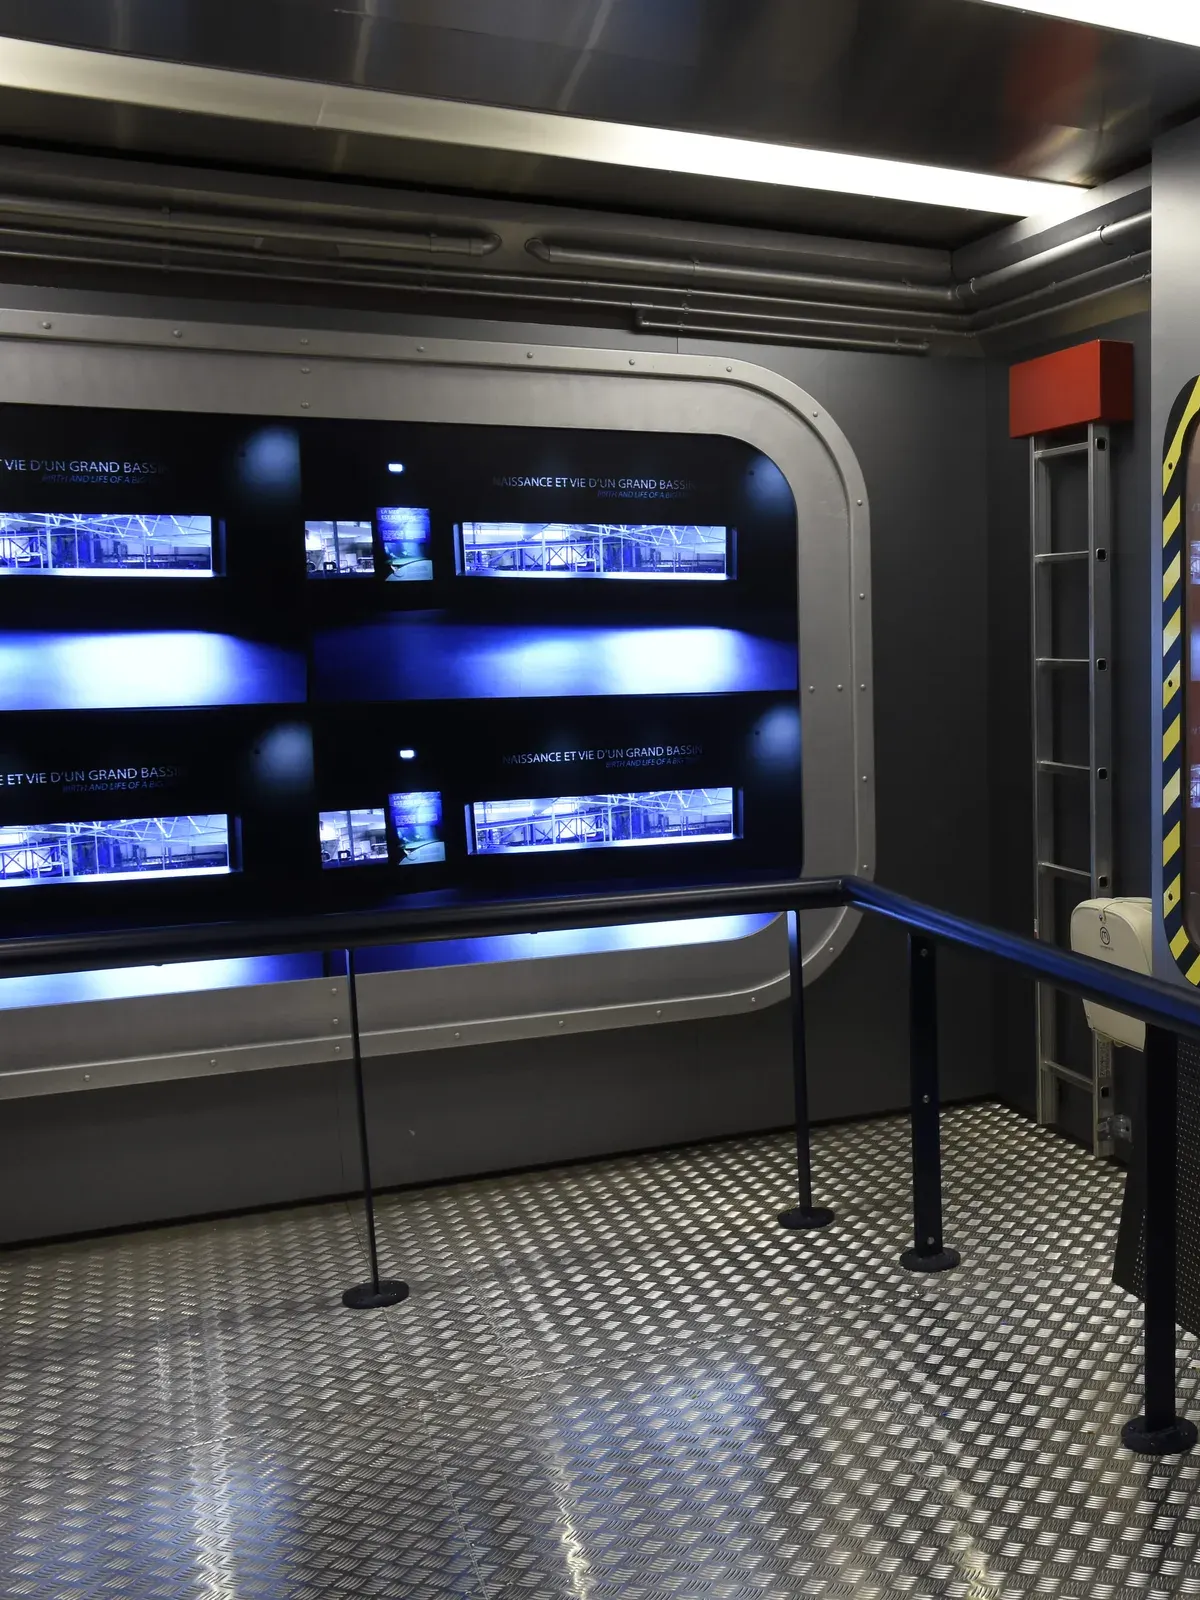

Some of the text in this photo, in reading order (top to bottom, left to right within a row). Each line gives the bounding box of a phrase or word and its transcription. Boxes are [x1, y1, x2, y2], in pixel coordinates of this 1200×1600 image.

[5, 459, 27, 471] VIE
[30, 459, 66, 472] D'UN
[69, 460, 120, 473] GRAND
[493, 476, 553, 488] NAISSANCE
[555, 477, 568, 488] ET
[569, 477, 587, 488] VIE
[589, 478, 616, 489] D'UN
[618, 478, 657, 490] GRAND
[502, 751, 562, 764] NAISSANCE
[564, 750, 577, 762] ET
[578, 749, 595, 761] VIE
[597, 748, 624, 760] D'UN
[626, 746, 664, 758] GRAND
[7, 773, 24, 786] ET
[25, 772, 47, 785] VIE
[50, 770, 85, 783] D'UN
[88, 767, 138, 781] GRAND
